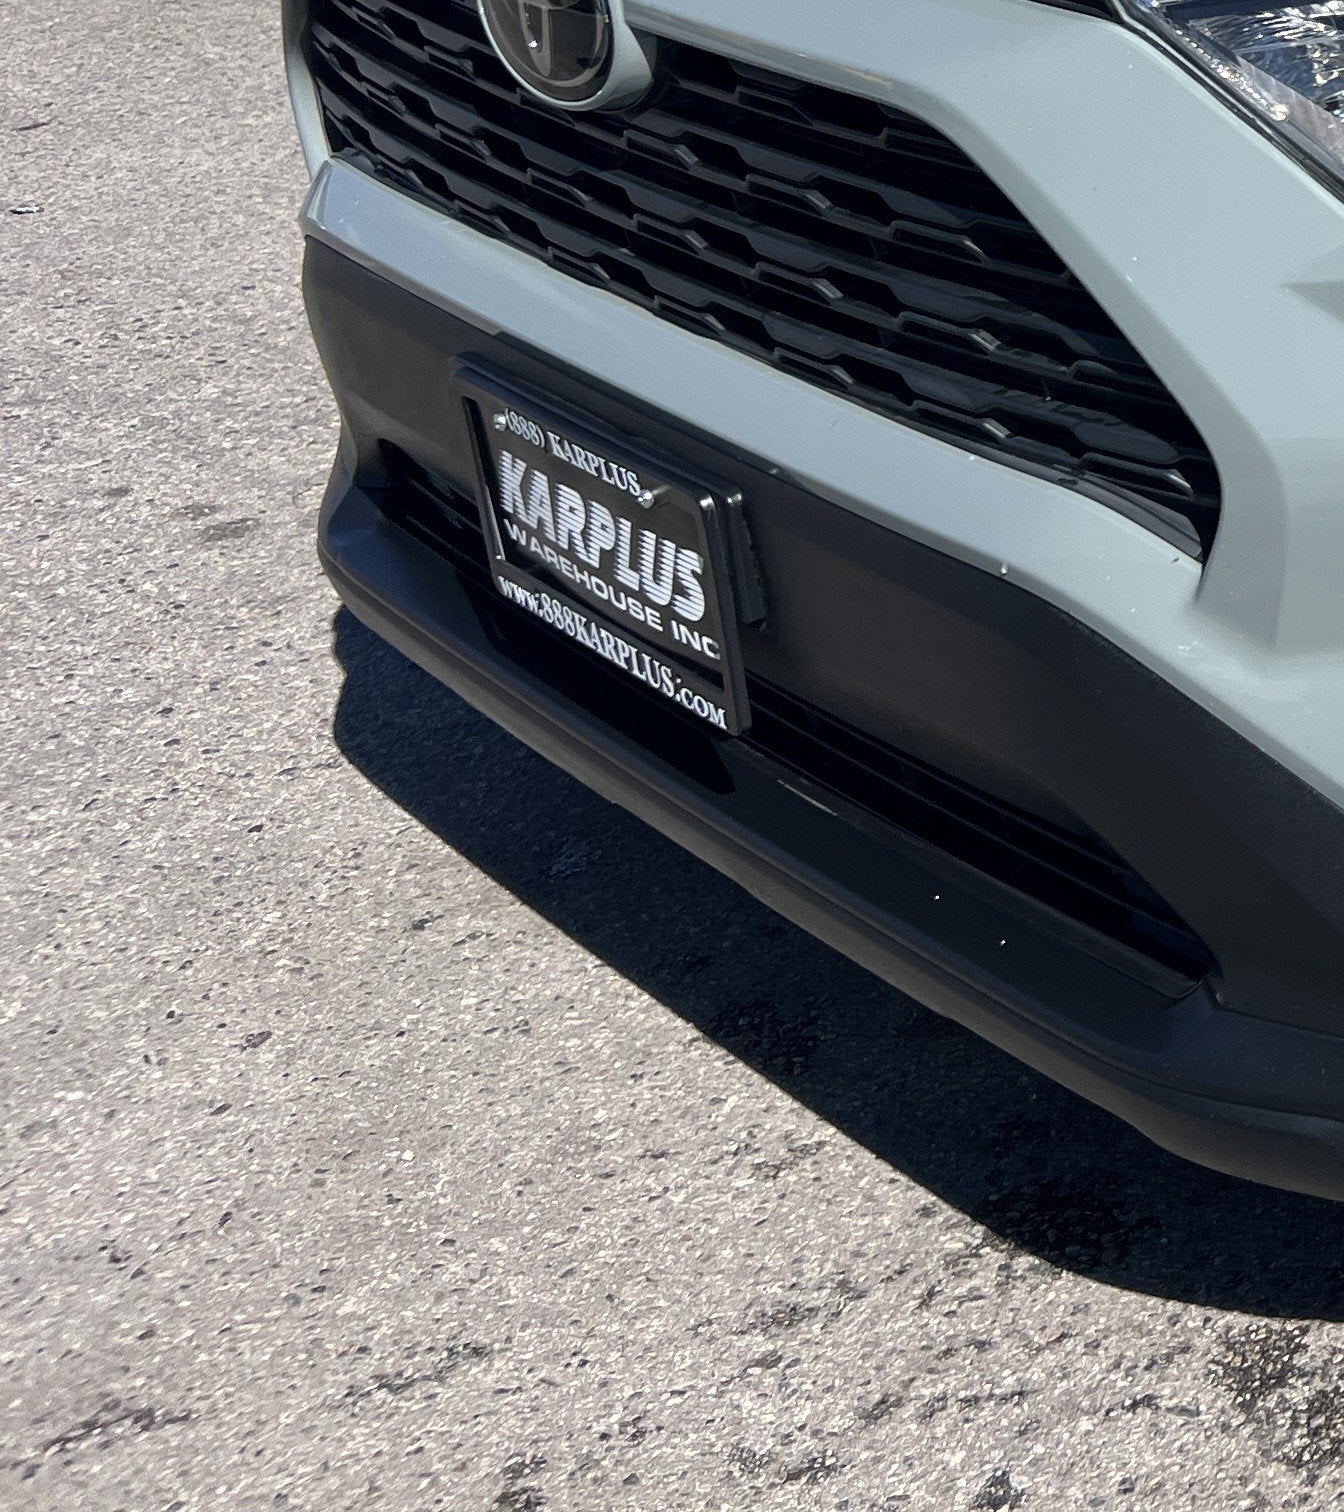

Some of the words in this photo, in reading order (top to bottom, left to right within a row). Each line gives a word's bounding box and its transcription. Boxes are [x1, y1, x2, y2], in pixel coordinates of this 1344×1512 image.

[504, 408, 547, 449] (888)
[547, 430, 642, 496] KARPLUS
[498, 450, 705, 622] KARPLUS
[502, 518, 664, 632] WAREHOUSE
[671, 619, 721, 660] INC
